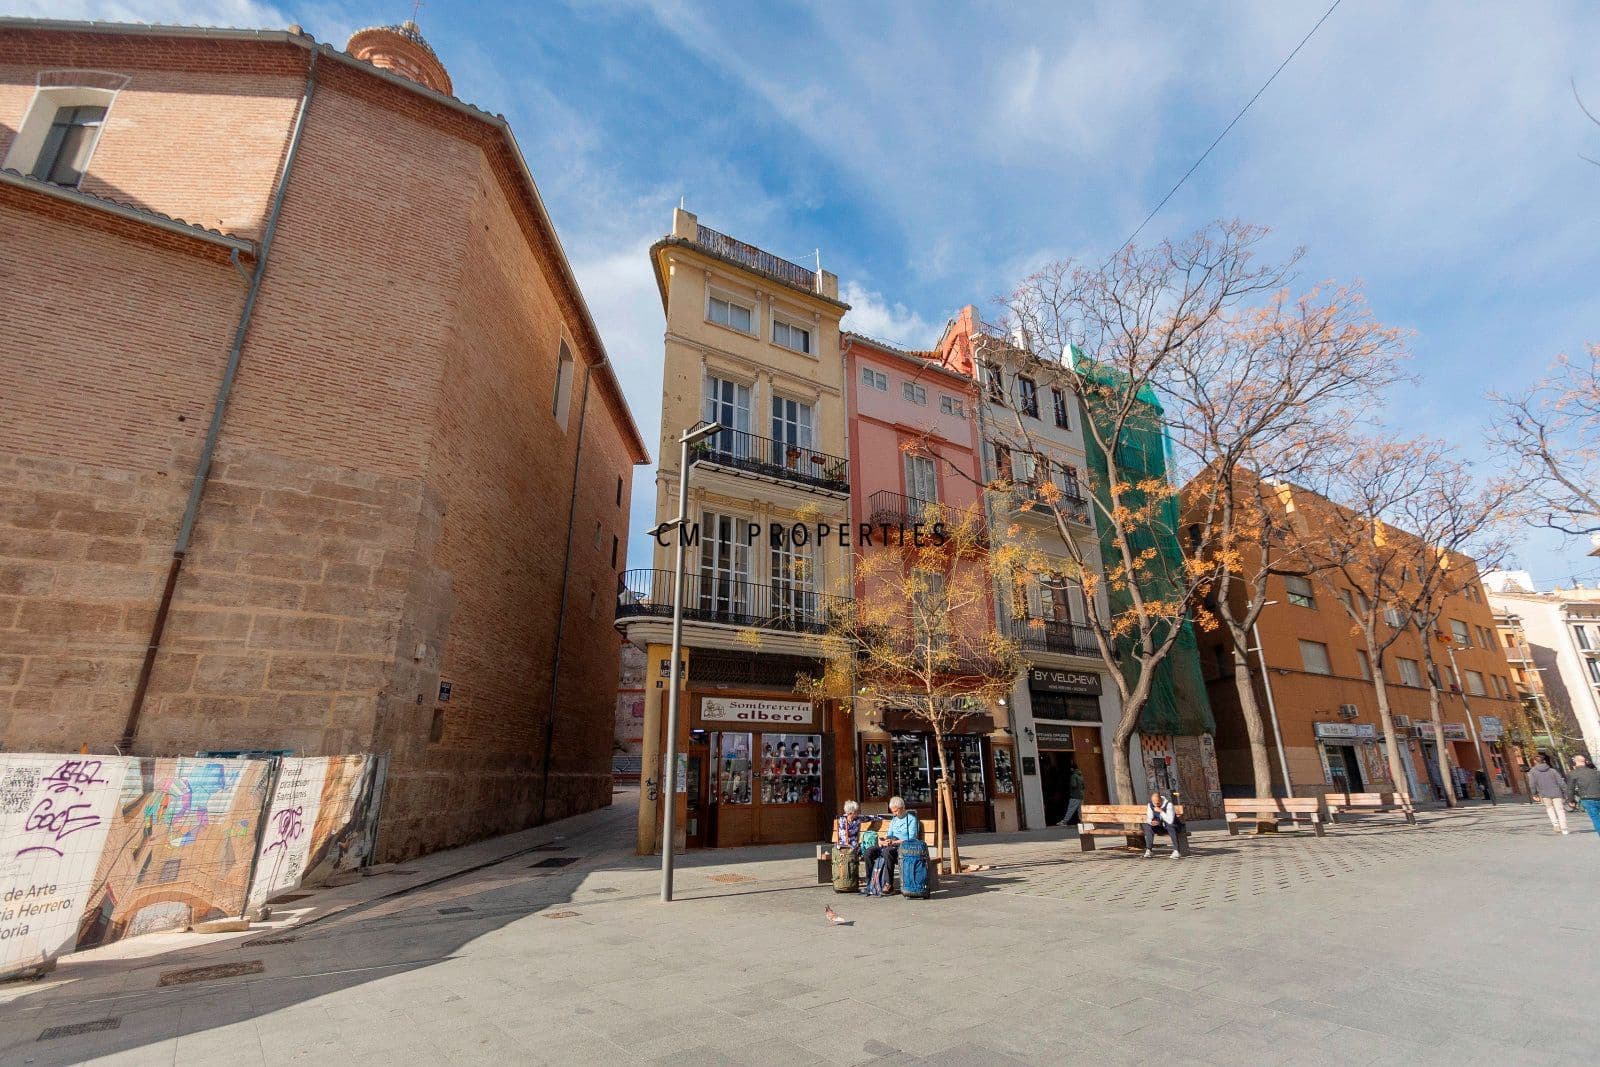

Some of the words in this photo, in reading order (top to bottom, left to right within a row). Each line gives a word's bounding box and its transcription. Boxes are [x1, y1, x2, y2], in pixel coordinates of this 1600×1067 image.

[1034, 670, 1048, 681] BY
[1050, 672, 1098, 686] VELCHEVA
[737, 711, 803, 722] albero
[4, 887, 24, 902] de
[25, 882, 57, 900] Arte
